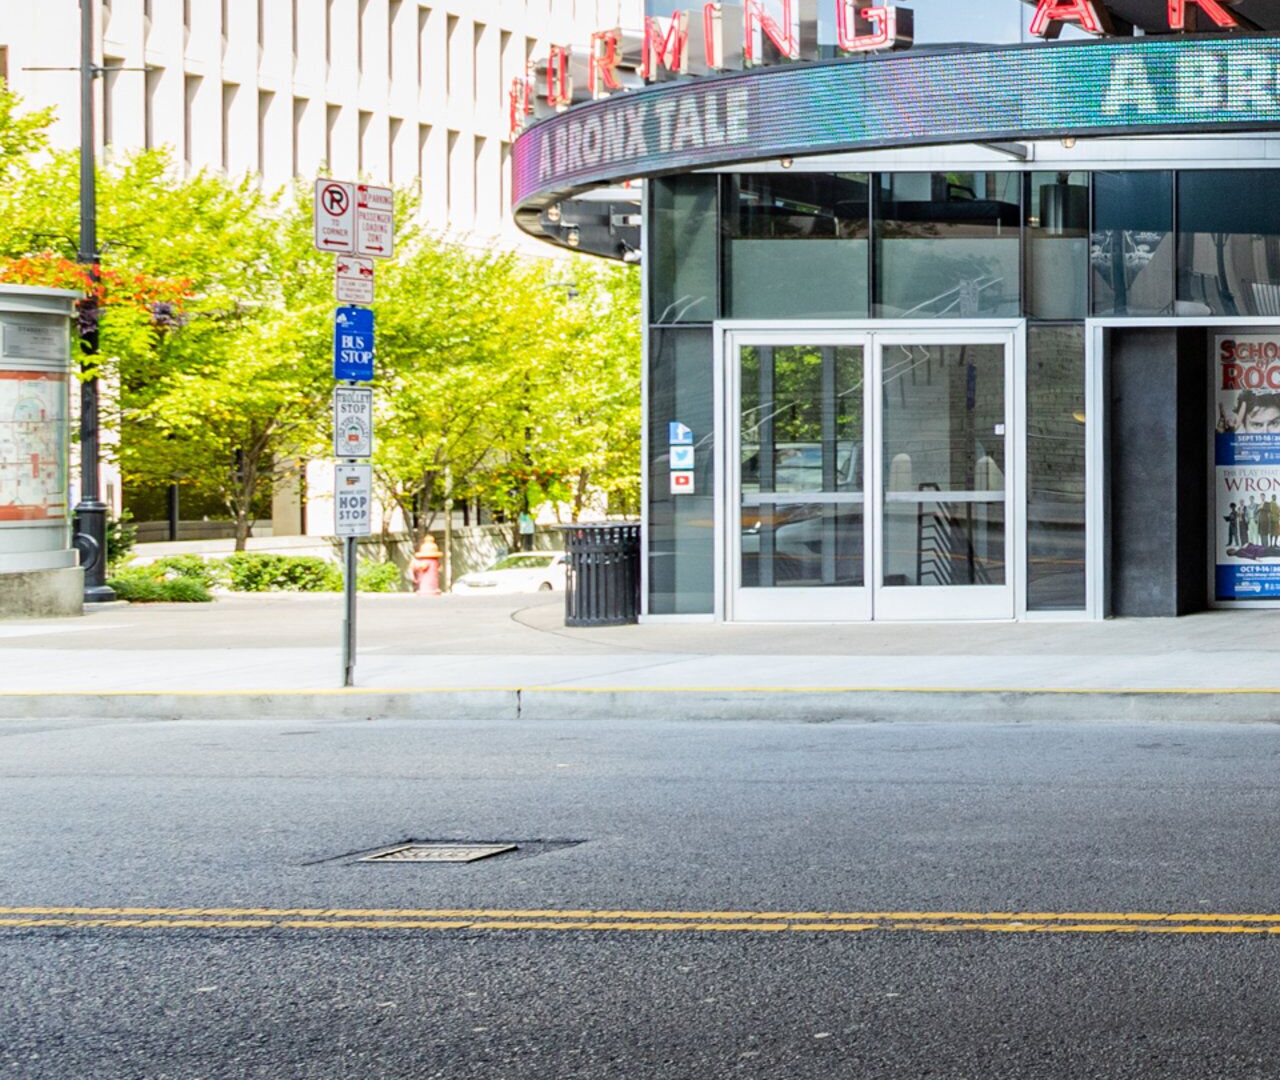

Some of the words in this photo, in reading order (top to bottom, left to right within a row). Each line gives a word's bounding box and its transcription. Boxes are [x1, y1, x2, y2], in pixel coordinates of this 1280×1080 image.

[1101, 53, 1157, 116] A
[539, 132, 552, 182] A
[555, 101, 649, 175] BRONX
[656, 86, 749, 152] TALE
[322, 227, 348, 235] CORNER
[342, 335, 364, 349] BUS
[341, 350, 372, 364] STOP
[337, 394, 370, 403] TROLLEY
[341, 404, 366, 413] STOP
[339, 496, 367, 509] HOP
[339, 510, 367, 520] STOP
